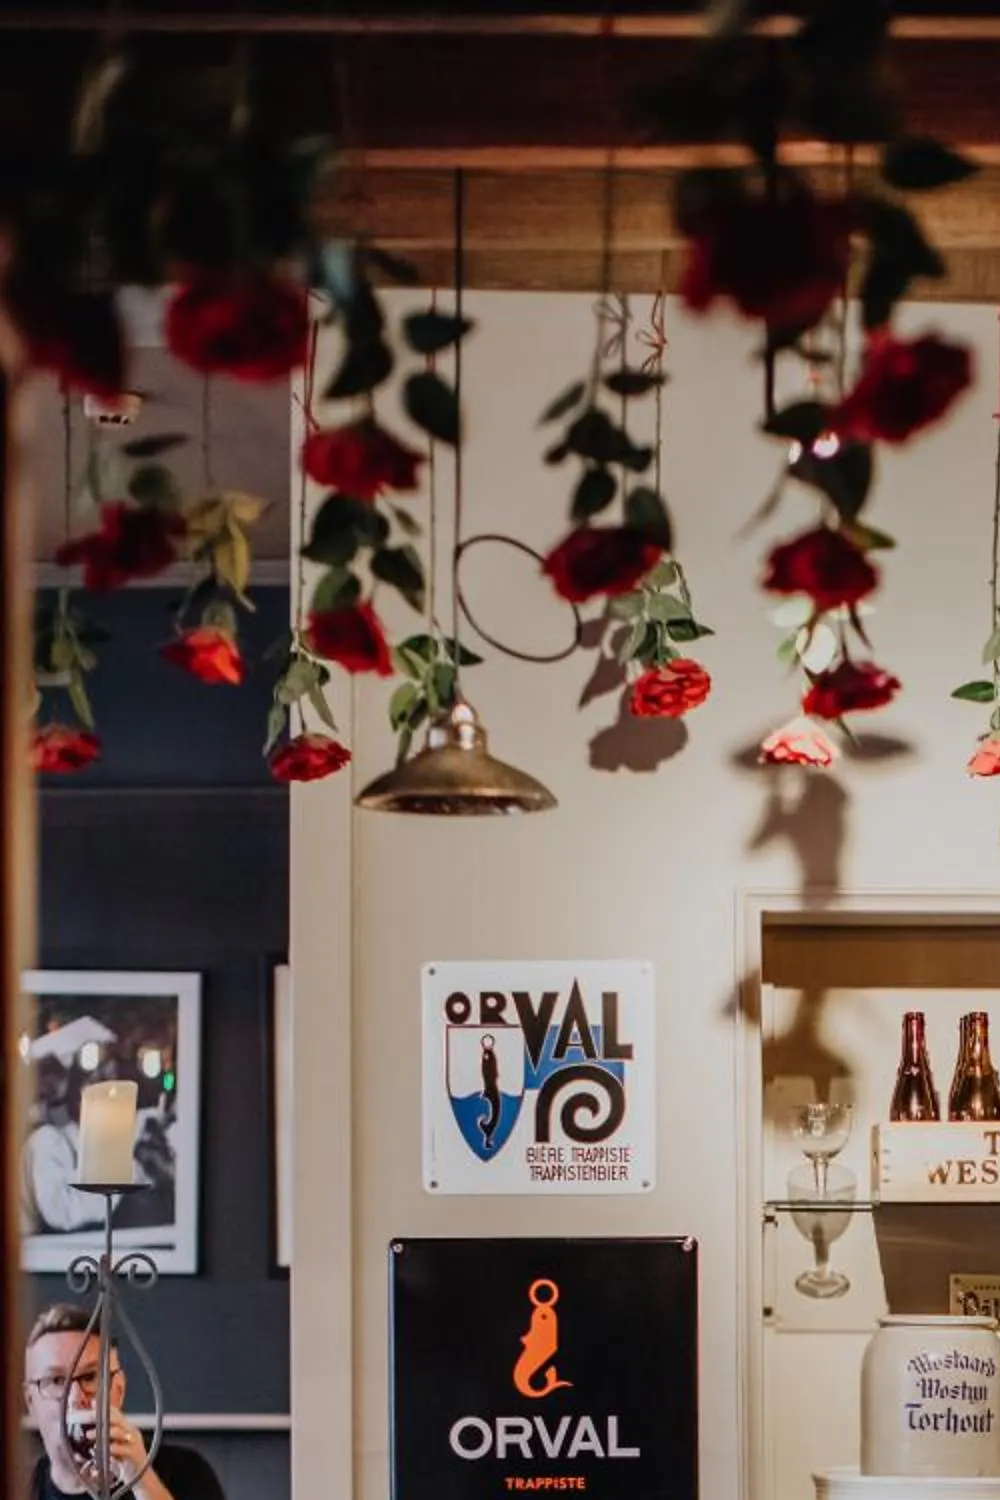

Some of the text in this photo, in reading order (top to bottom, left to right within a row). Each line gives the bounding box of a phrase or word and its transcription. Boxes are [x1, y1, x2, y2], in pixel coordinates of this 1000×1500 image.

[445, 976, 634, 1075] ORVAL
[571, 1147, 632, 1163] TRAPPISTE
[530, 1165, 629, 1181] TRAPPISTENBIER
[904, 1403, 994, 1434] Torhout
[449, 1416, 641, 1460] ORVAL
[505, 1477, 587, 1490] TRAPPISTE
